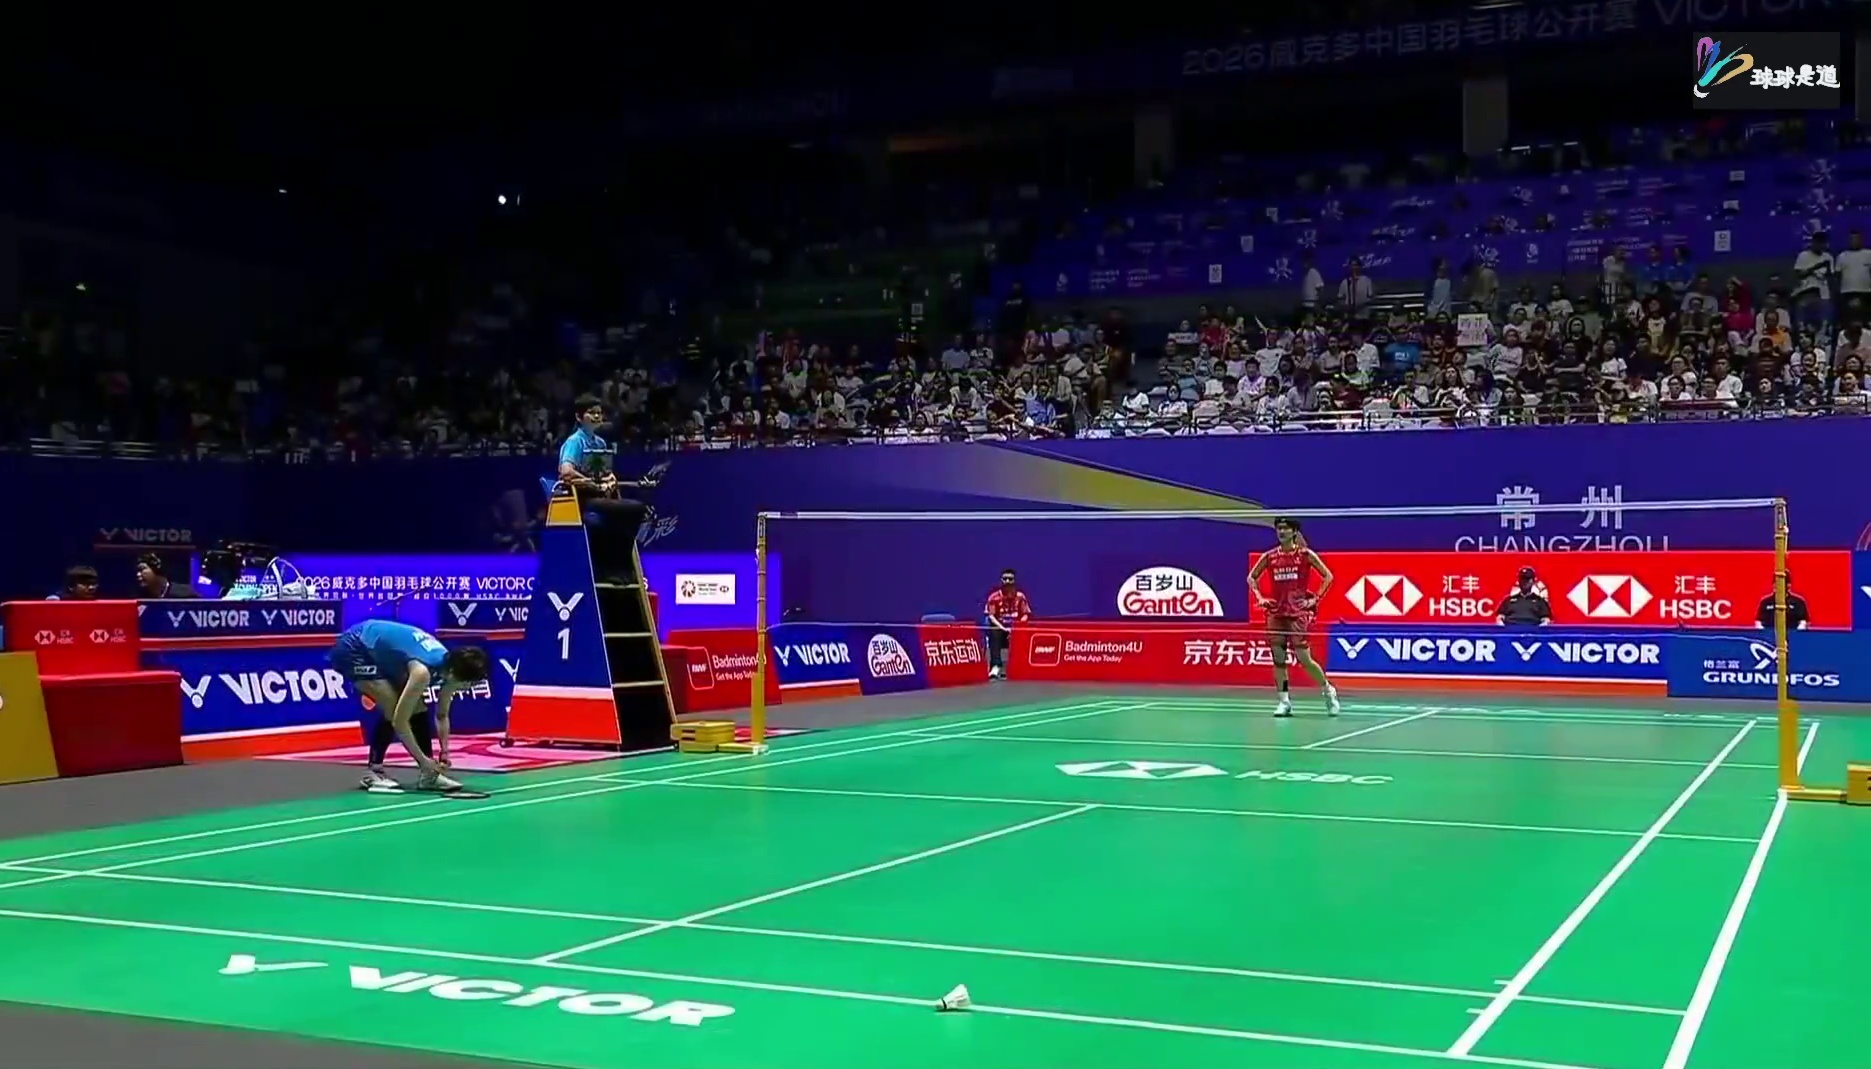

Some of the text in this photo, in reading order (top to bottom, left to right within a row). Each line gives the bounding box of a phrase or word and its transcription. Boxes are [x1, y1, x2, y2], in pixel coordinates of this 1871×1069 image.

[1497, 485, 1622, 530] 常州
[123, 527, 192, 543] VICTOR
[476, 577, 526, 590] VICTOR
[1136, 574, 1193, 591] 百岁山
[1443, 574, 1480, 594] 汇丰
[1675, 575, 1716, 594] 汇丰
[1123, 591, 1214, 614] Ganten
[1429, 597, 1494, 617] HSBC
[1659, 598, 1732, 619] HSBC
[189, 609, 335, 627] VICTOR VICTOR
[557, 628, 570, 659] 1
[792, 642, 851, 665] VICTOR
[872, 640, 897, 656] 百岁山
[924, 638, 981, 667] 京东运动
[1065, 640, 1143, 653] Badminton4U
[1375, 638, 1660, 664] VICTOR VICTOR
[872, 655, 912, 674] Ganten
[1087, 655, 1102, 663] App
[219, 668, 348, 705] VICTOR
[1234, 771, 1394, 784] HSBC
[350, 964, 736, 1026] VICTOR
